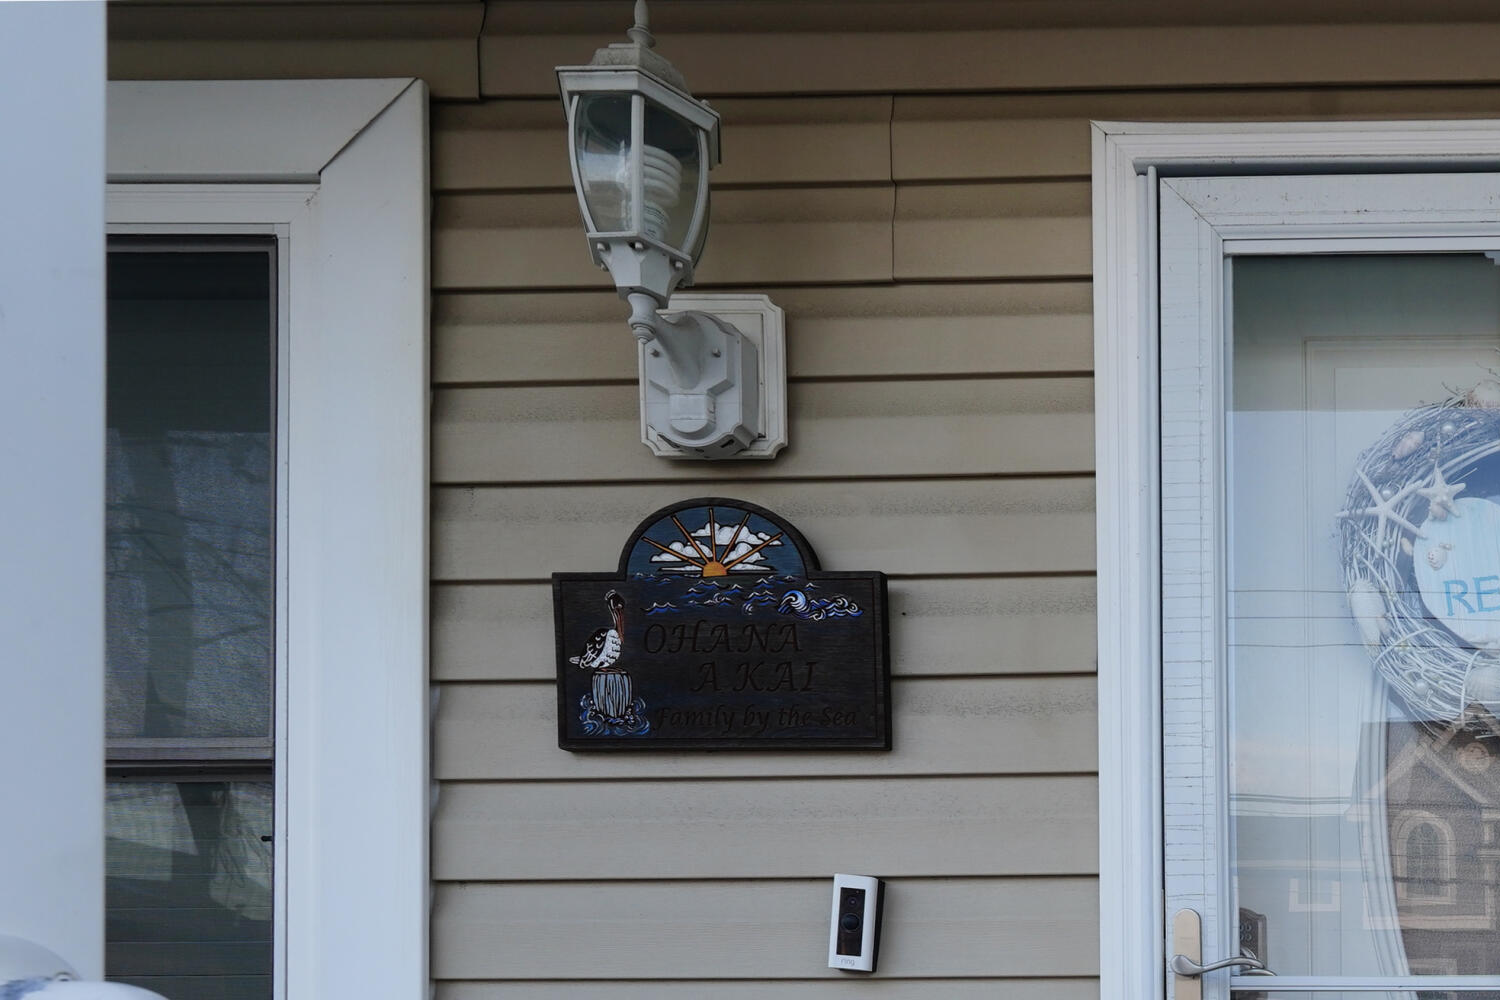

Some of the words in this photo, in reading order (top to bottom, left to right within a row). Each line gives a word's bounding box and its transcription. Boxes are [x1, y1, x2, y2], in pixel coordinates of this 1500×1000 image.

[643, 619, 803, 653] OHANA
[689, 660, 721, 691] A
[732, 660, 818, 691] KAI
[652, 704, 735, 733] Family
[744, 704, 769, 732] by
[778, 705, 811, 727] the
[820, 706, 857, 727] Sea
[840, 957, 855, 967] ring
